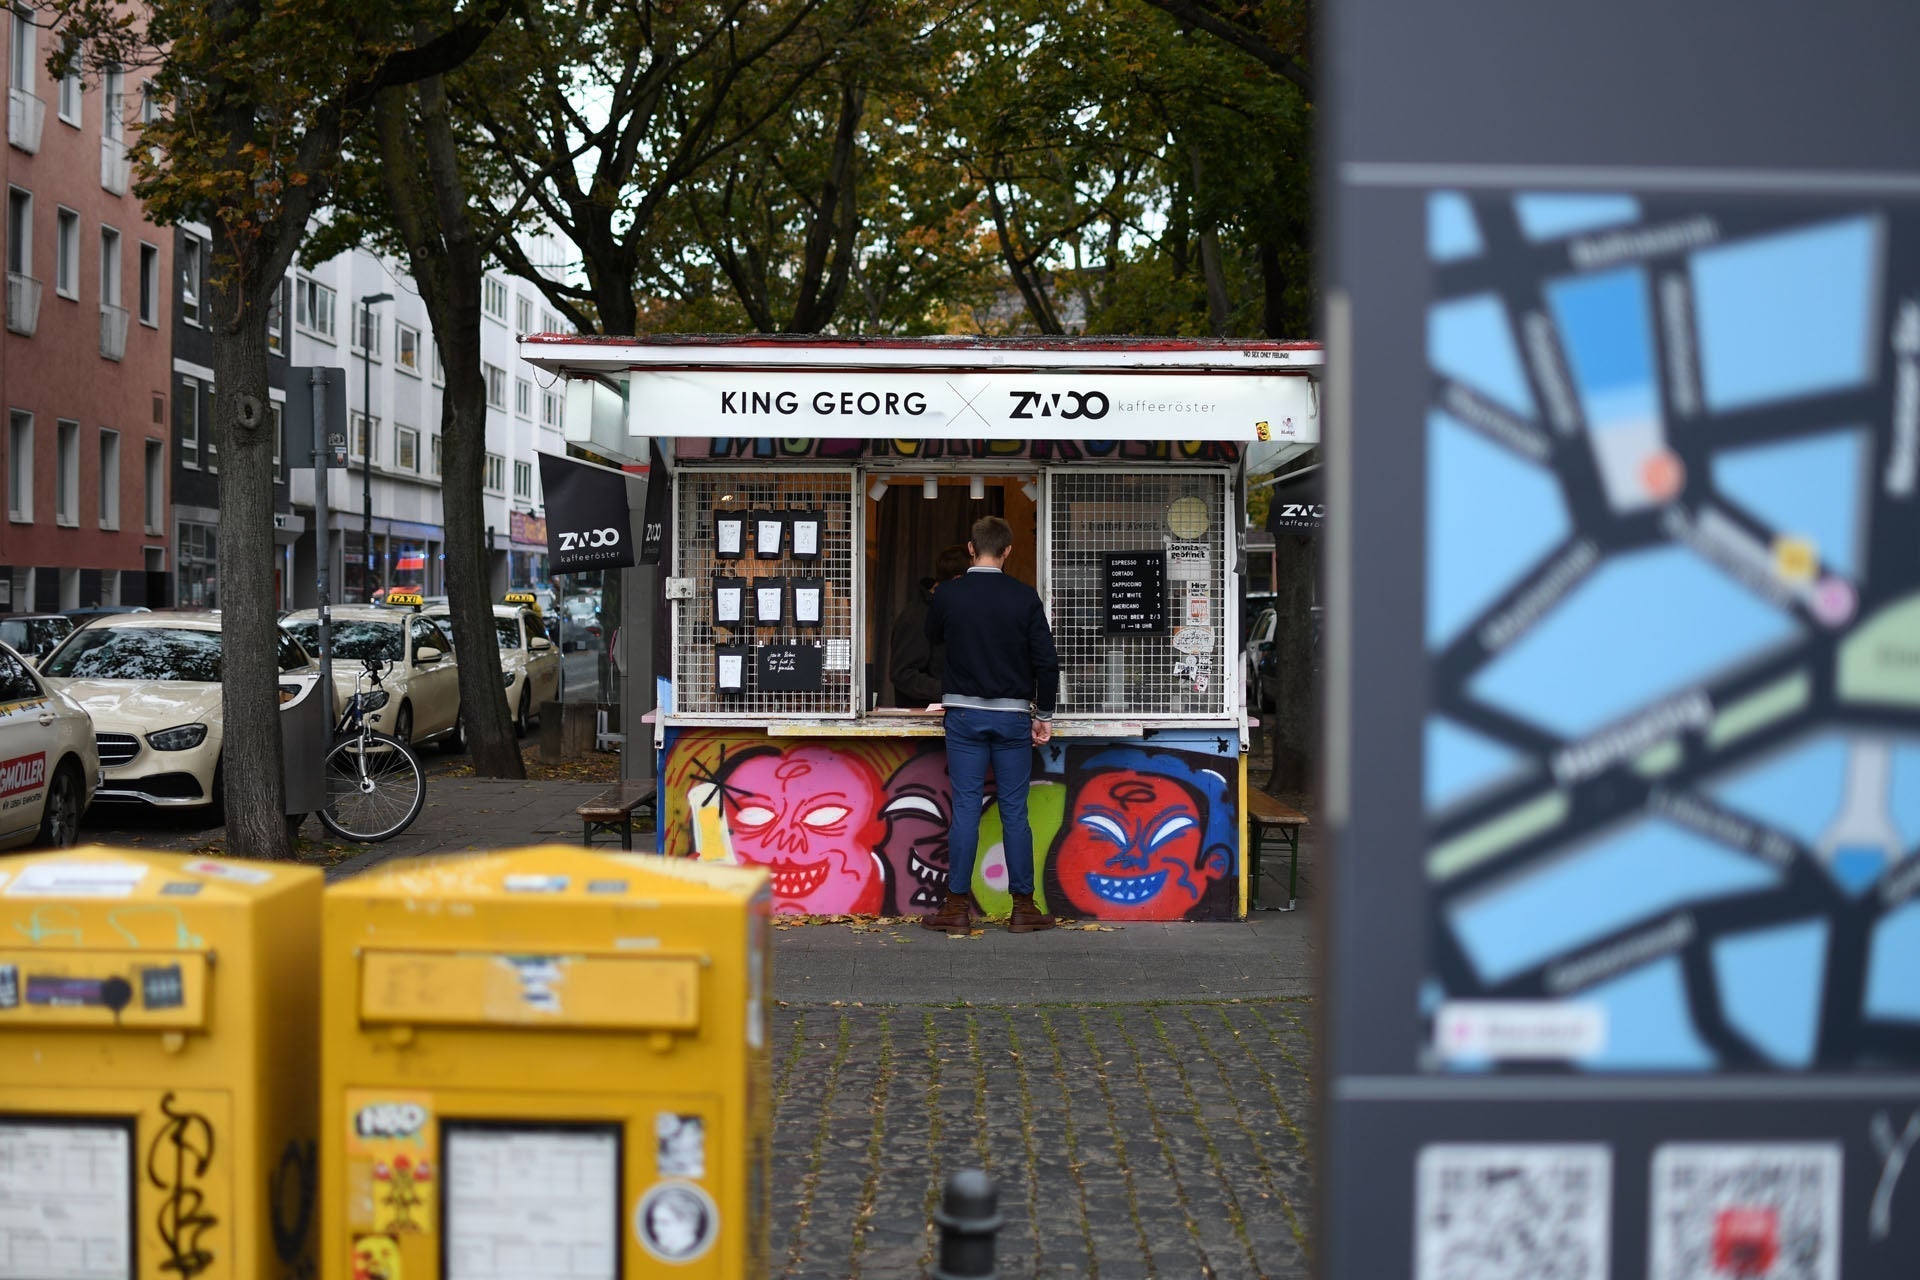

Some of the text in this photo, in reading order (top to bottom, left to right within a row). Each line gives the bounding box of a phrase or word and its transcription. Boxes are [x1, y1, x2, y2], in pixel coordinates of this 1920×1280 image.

[721, 391, 799, 415] KING
[812, 391, 927, 416] GEORG
[1118, 400, 1217, 414] kaffeeröster
[560, 551, 621, 563] kaffeeröster
[391, 595, 417, 604] TAXI
[509, 594, 531, 602] TAXI
